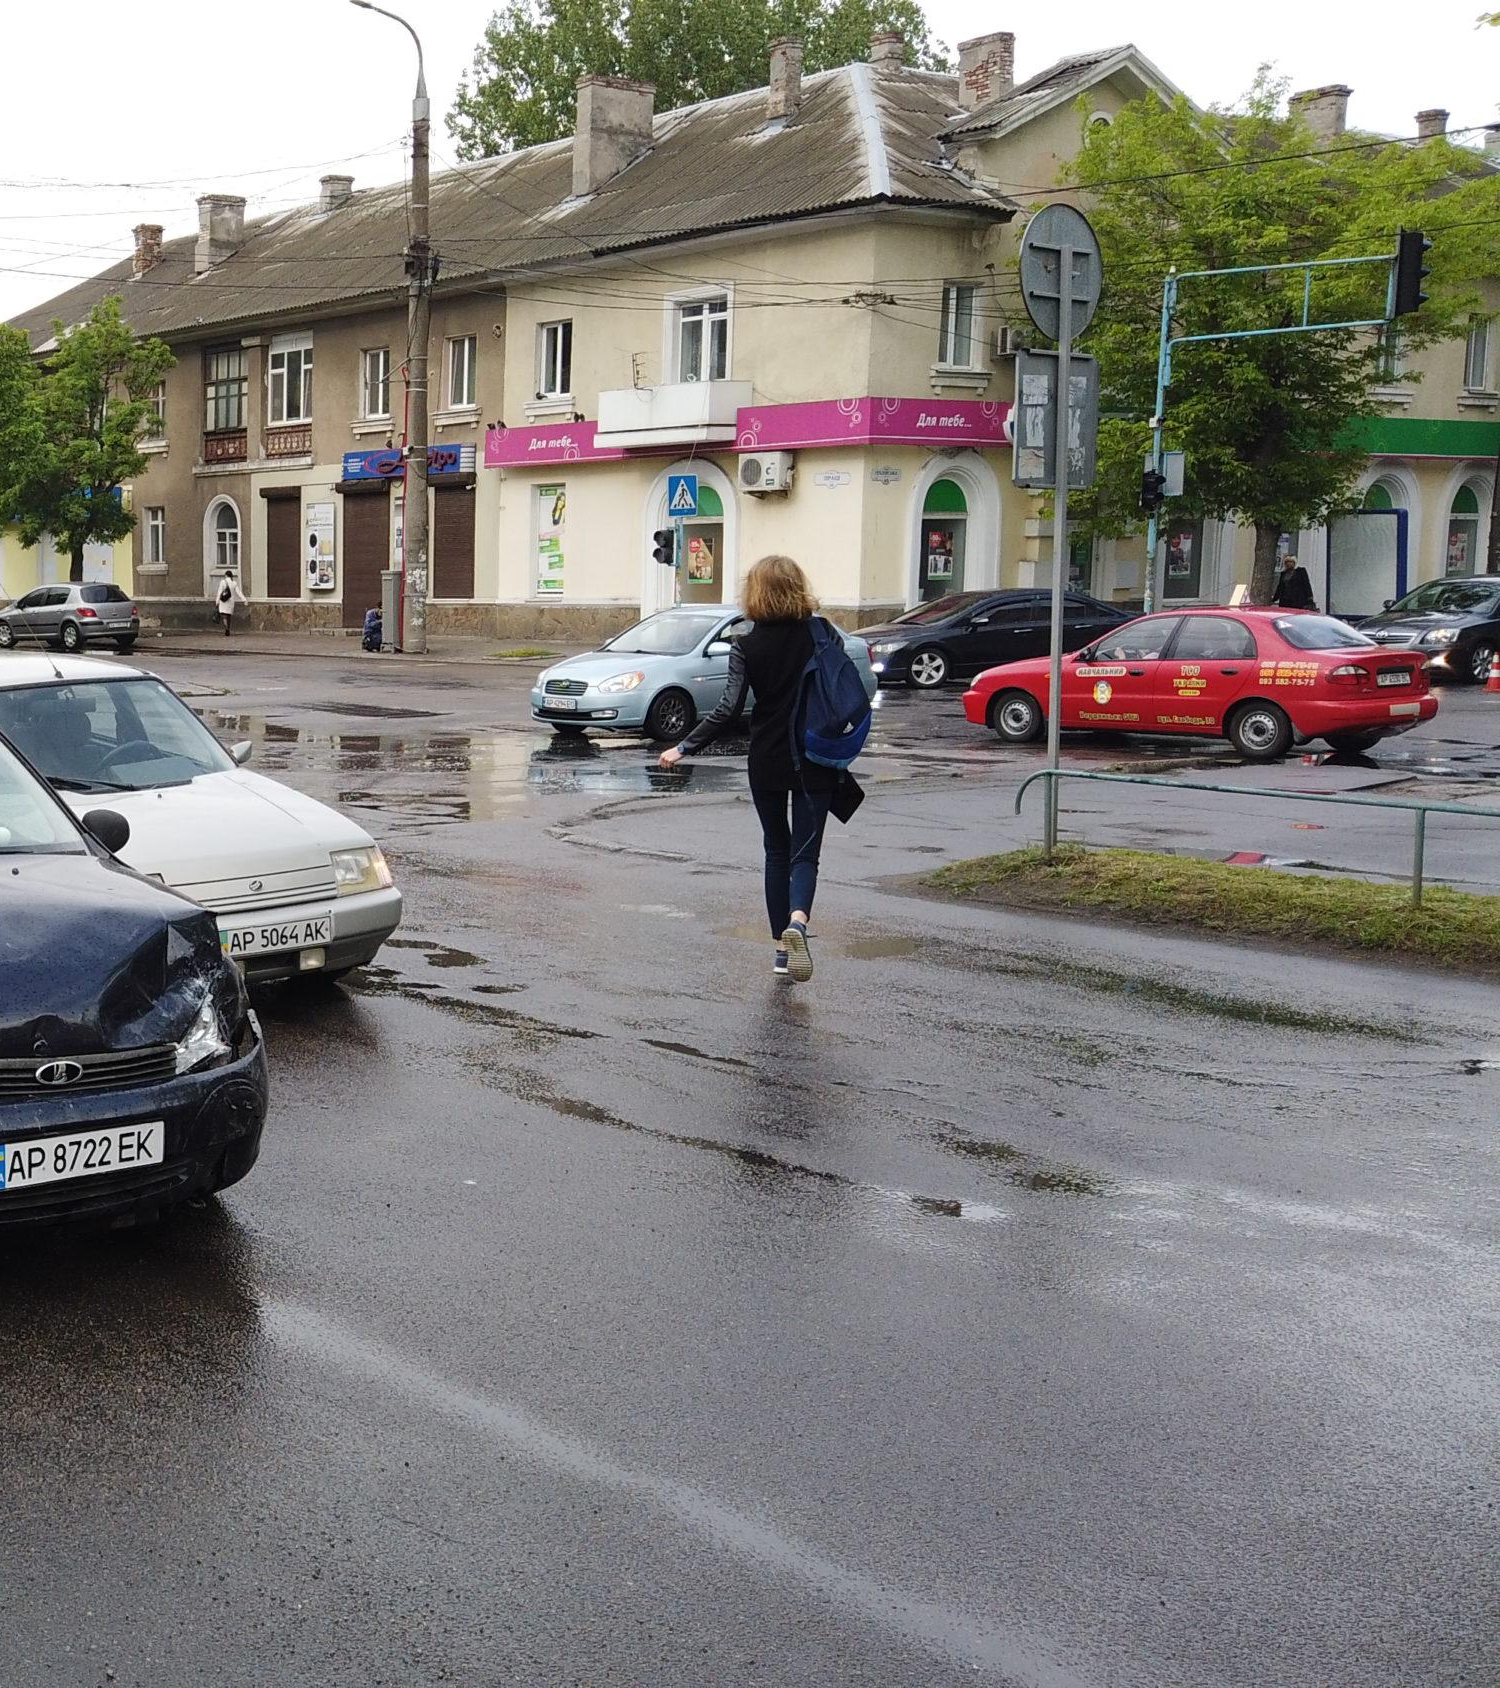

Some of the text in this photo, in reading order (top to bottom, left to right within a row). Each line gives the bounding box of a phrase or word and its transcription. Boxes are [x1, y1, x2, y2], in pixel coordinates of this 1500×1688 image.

[916, 412, 936, 428] Для
[528, 438, 547, 452] Для
[229, 920, 326, 953] AP 5064 AK
[7, 1128, 154, 1183] AP 8722 EK
